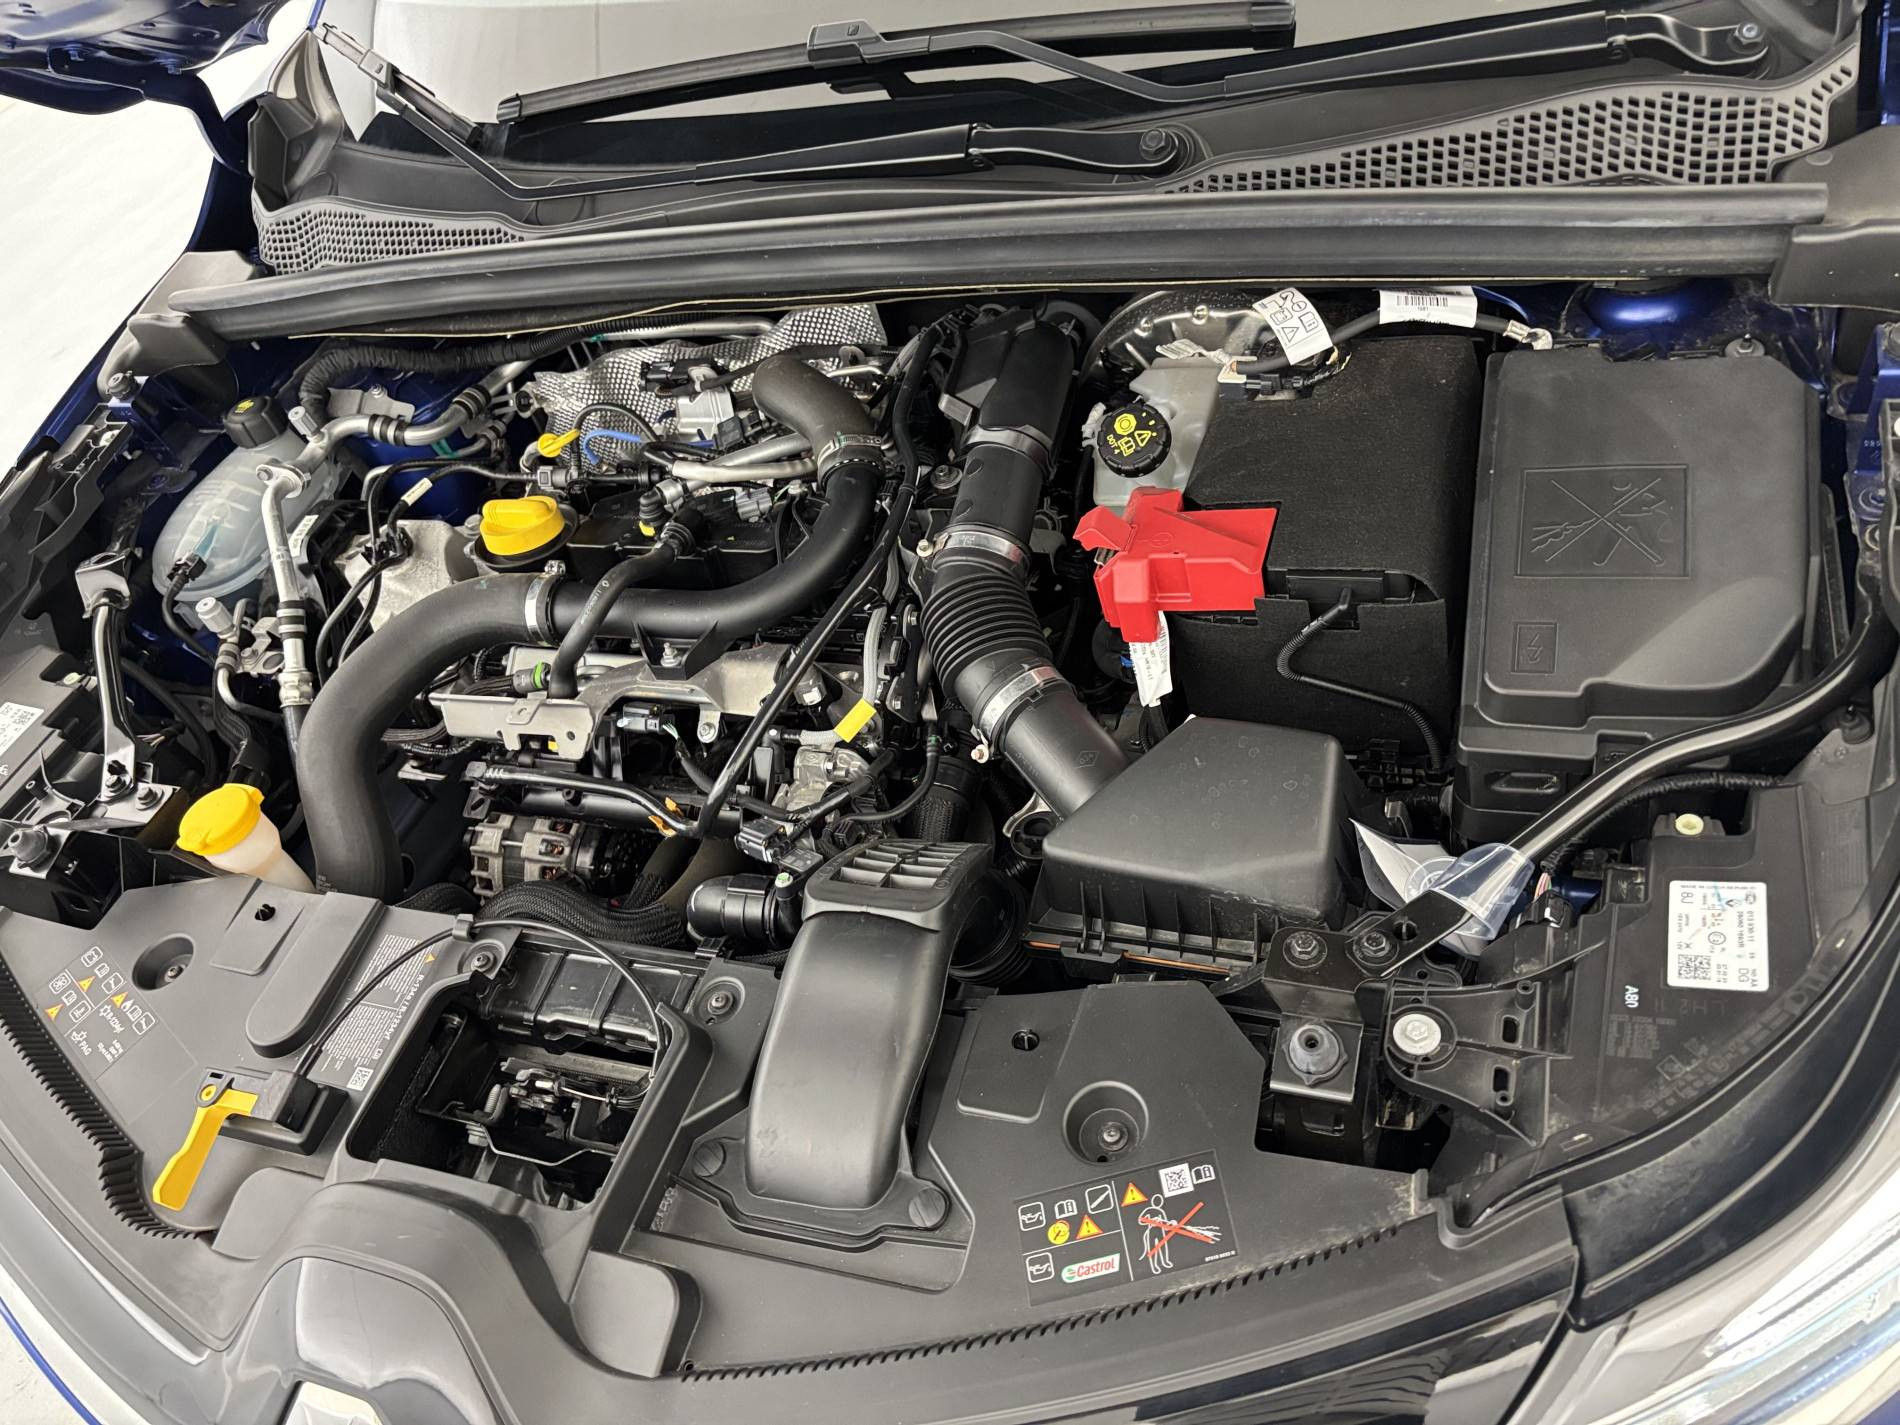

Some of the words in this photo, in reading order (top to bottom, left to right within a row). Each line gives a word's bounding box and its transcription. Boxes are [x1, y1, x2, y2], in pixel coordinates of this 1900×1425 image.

[1106, 434, 1118, 448] DOT
[1624, 985, 1639, 1009] A80
[79, 1040, 92, 1056] PAG
[1077, 1257, 1115, 1277] Castrol
